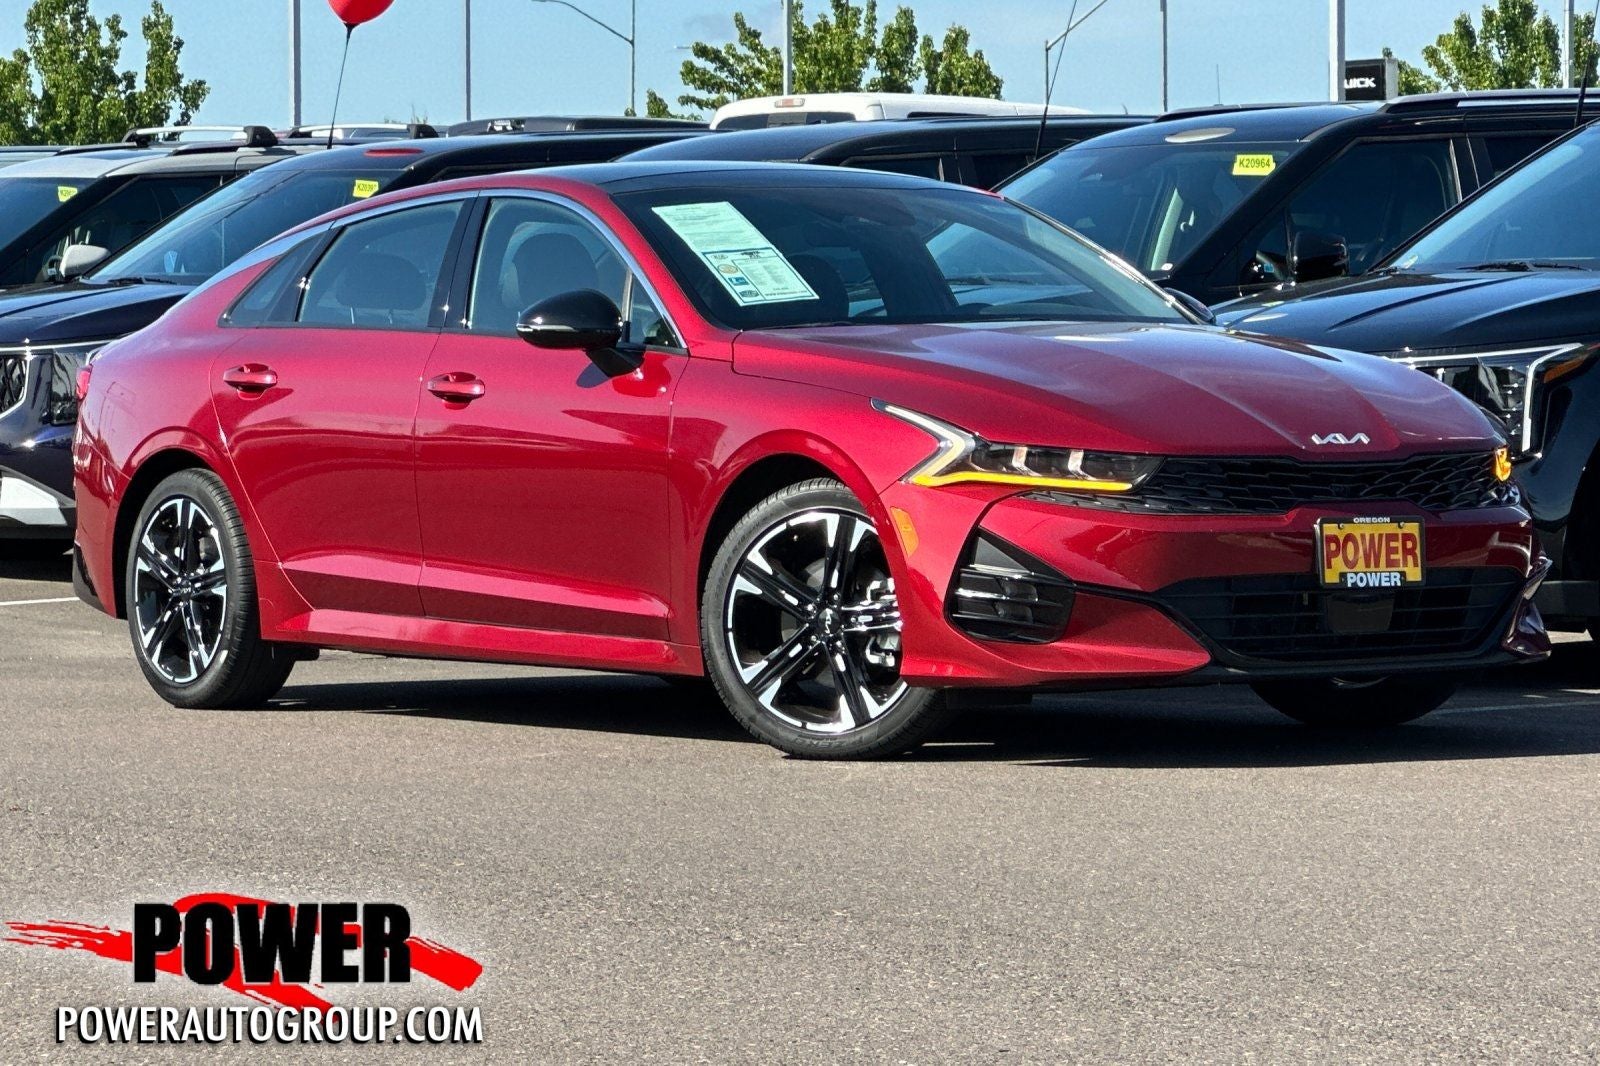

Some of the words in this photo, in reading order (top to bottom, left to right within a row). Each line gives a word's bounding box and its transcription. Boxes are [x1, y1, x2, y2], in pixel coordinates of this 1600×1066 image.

[1343, 77, 1376, 89] UICK
[1239, 158, 1271, 168] K20964
[1325, 532, 1419, 570] POWER
[1347, 571, 1402, 588] POWER
